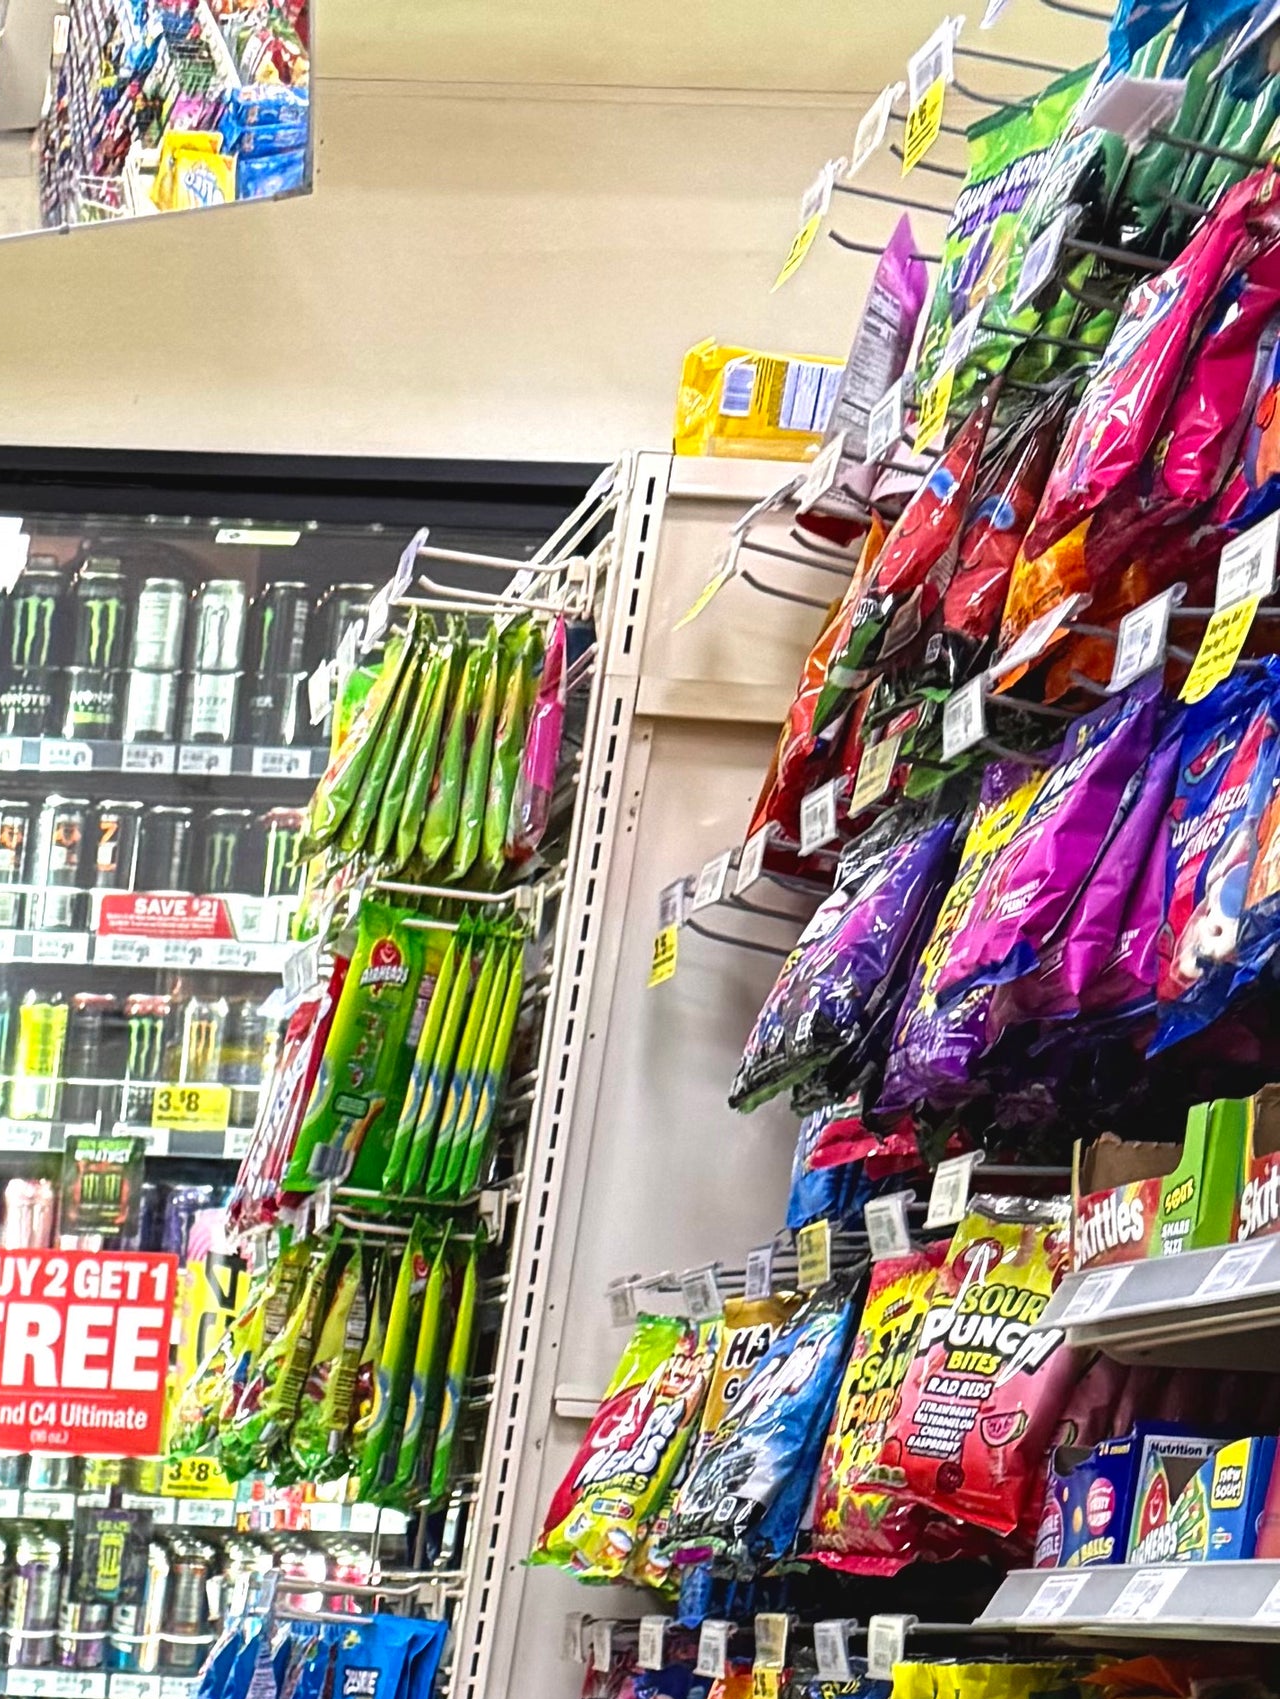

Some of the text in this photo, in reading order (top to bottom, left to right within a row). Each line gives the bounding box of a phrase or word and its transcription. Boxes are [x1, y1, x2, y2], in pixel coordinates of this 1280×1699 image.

[133, 898, 187, 916] SAVE
[157, 1089, 173, 1114] 3
[1075, 1188, 1145, 1263] Skittles
[43, 1259, 70, 1299] 2
[74, 1261, 145, 1301] GET
[147, 1262, 170, 1301] 1
[958, 1284, 1049, 1324] SOUR
[919, 1307, 1065, 1370] PUNCH
[946, 1350, 1002, 1374] BITES
[927, 1377, 993, 1398] RAD REDS
[28, 1402, 57, 1428] C4
[60, 1403, 149, 1431] Ultimate
[914, 1412, 975, 1430] WATERMELON
[921, 1401, 979, 1418] STRAWBERRY
[1151, 1442, 1202, 1457] Nutrition
[168, 1459, 183, 1481] 3
[1219, 1466, 1242, 1483] new
